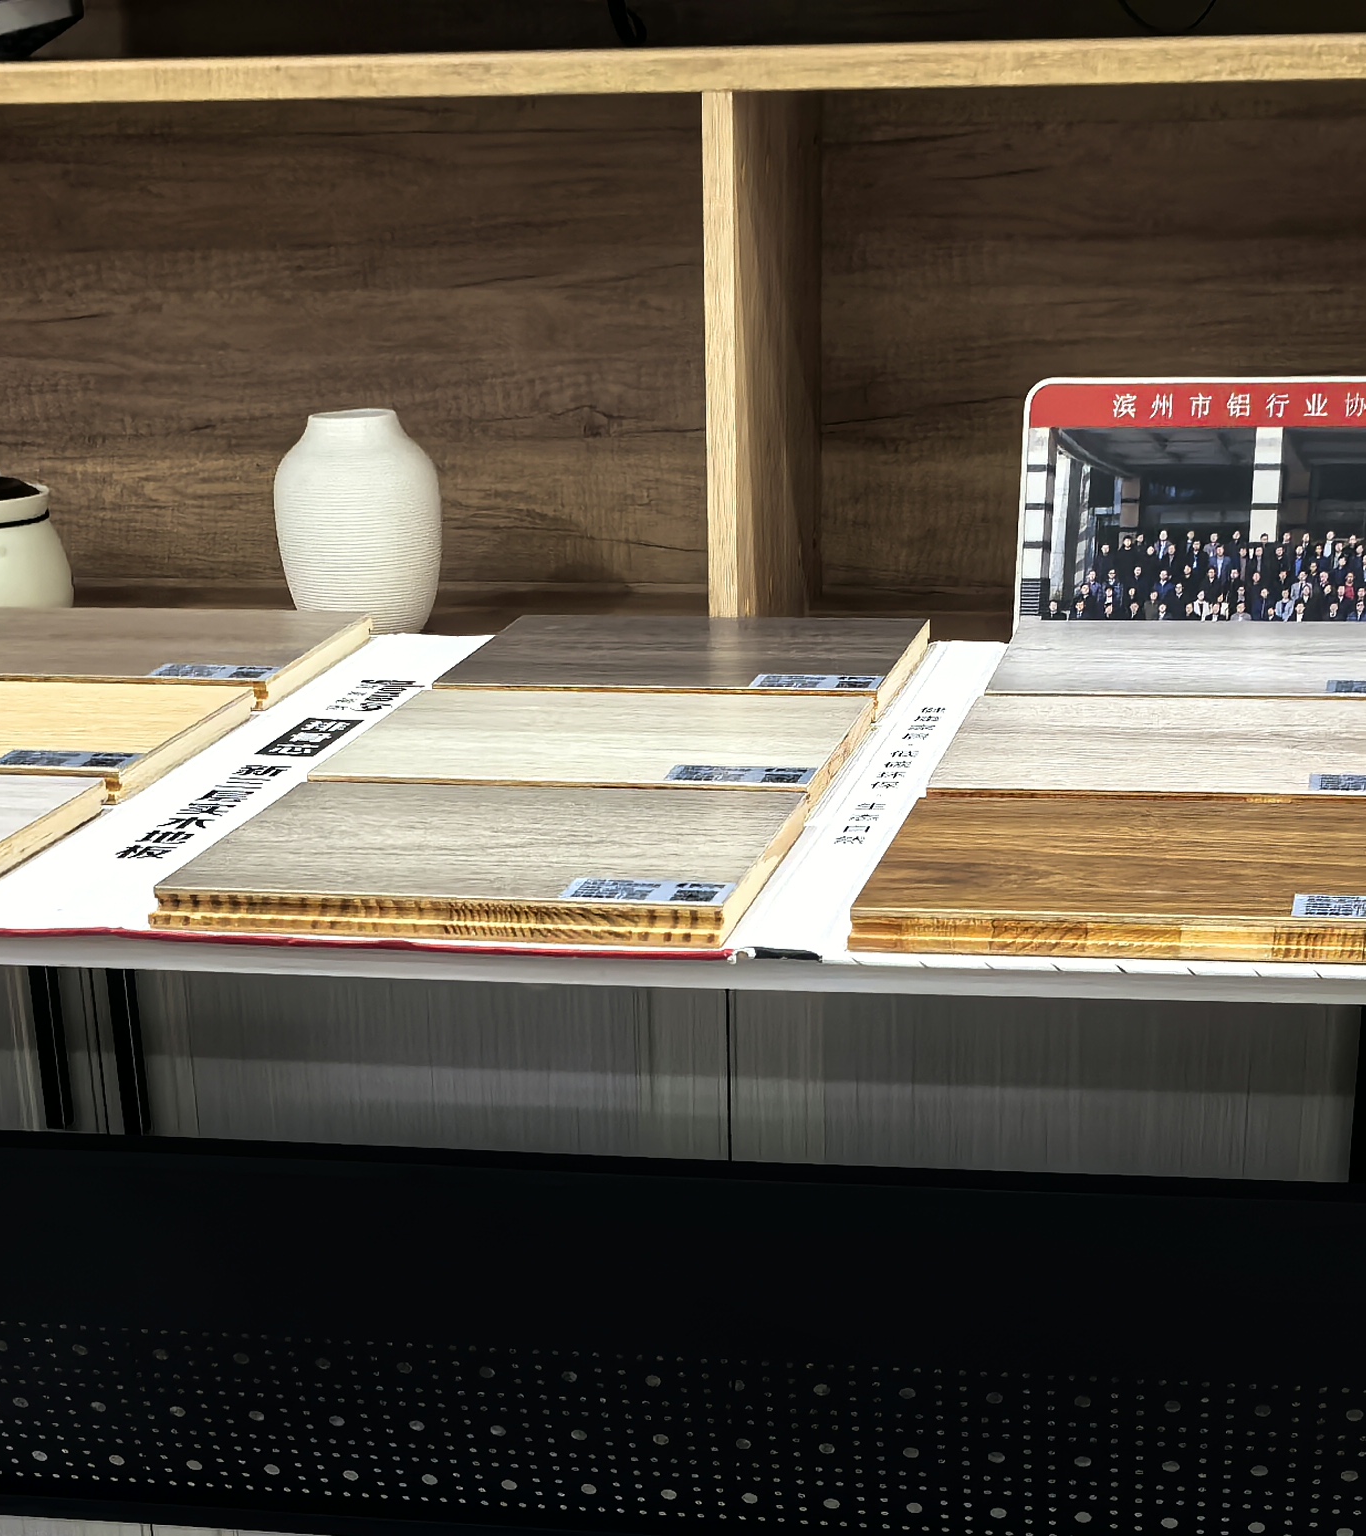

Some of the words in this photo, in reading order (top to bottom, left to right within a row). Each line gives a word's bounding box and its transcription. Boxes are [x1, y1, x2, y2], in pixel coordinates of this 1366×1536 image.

[115, 764, 292, 859] 新三层实木地板
